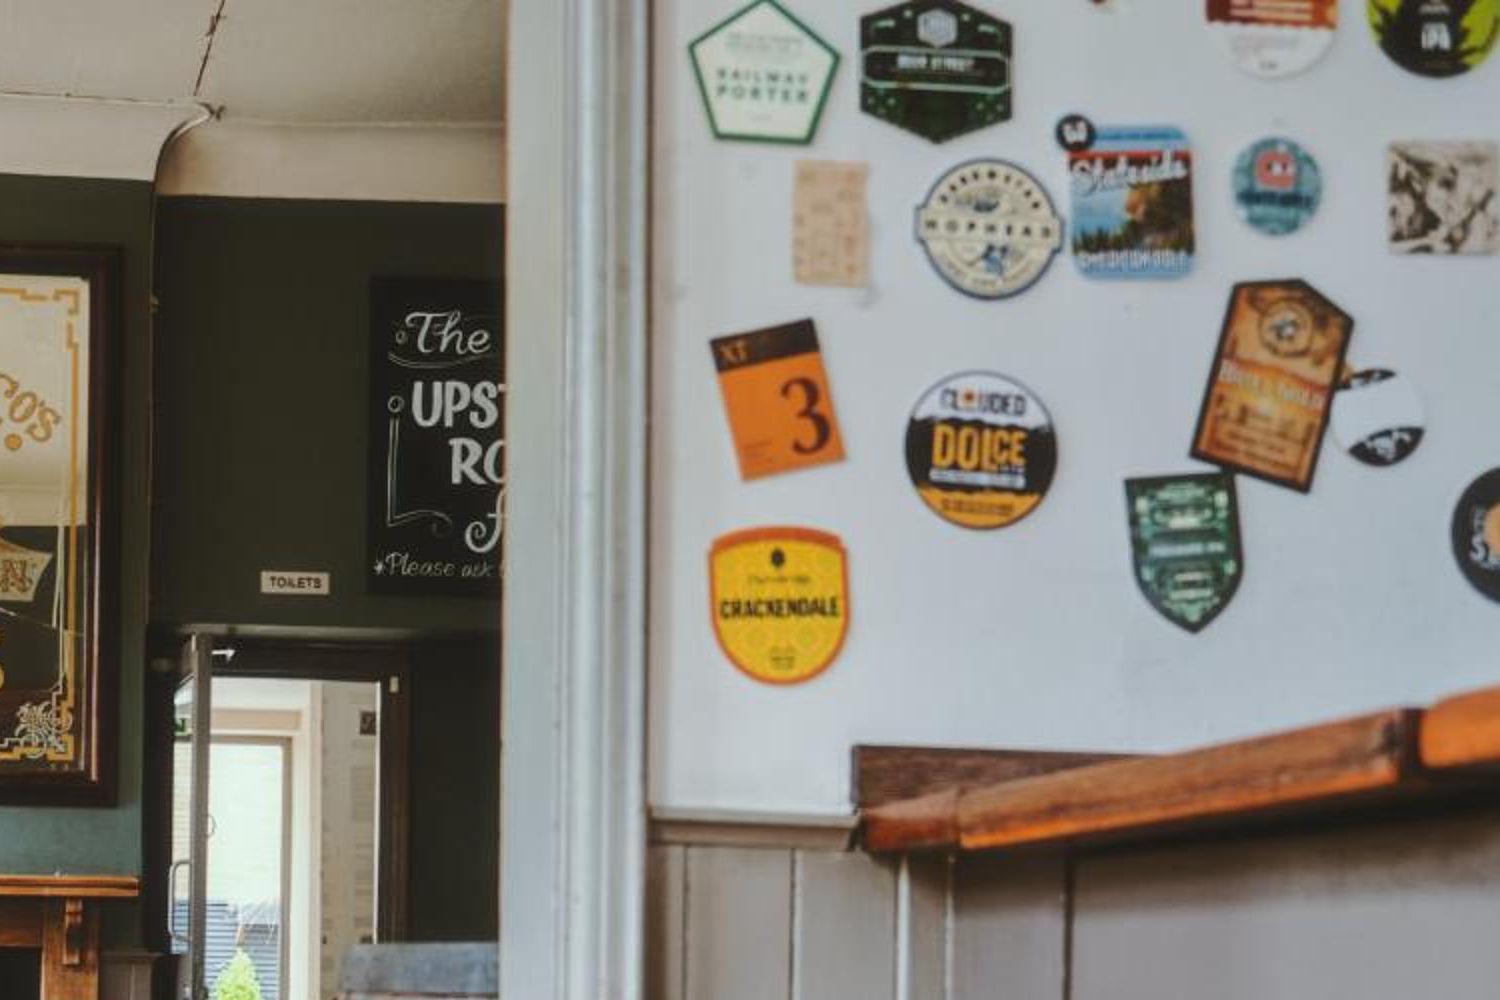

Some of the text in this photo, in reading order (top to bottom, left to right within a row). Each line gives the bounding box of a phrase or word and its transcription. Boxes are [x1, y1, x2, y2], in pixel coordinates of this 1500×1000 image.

[717, 84, 808, 103] PORTER
[924, 218, 1052, 239] HOPHEAD
[405, 310, 491, 354] The
[412, 380, 506, 429] UPS
[779, 375, 832, 456] 3
[932, 422, 1028, 474] DOLCE
[269, 575, 322, 589] TOILETS
[720, 596, 841, 620] CRACKENDALE
